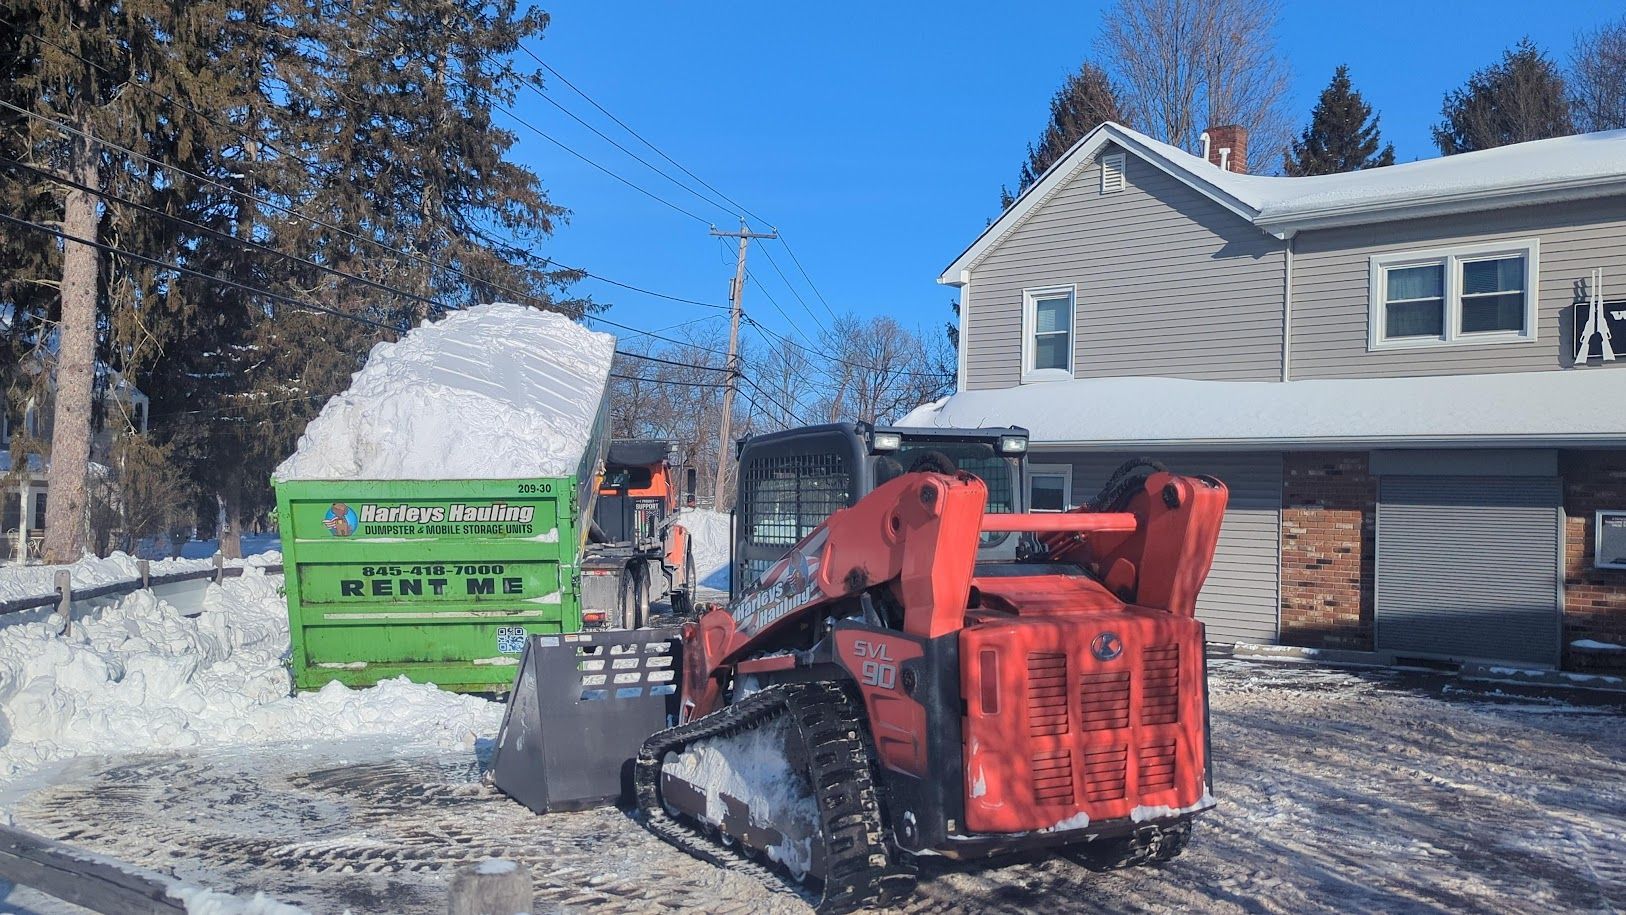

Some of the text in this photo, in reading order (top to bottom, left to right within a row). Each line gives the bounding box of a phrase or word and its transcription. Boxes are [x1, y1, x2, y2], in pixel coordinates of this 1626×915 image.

[518, 484, 552, 494] 209-30
[359, 503, 535, 524] Harleys Hauling
[365, 525, 415, 535] DUMPSTER
[426, 525, 461, 535] MOBILE
[463, 525, 503, 535] STORAGE
[505, 524, 533, 534] UNITS
[362, 565, 505, 576] 845-418-7000
[340, 577, 523, 597] RENT ME
[735, 582, 783, 622] Harleys
[759, 586, 811, 628] Hauling
[853, 639, 894, 662] SVL
[862, 660, 896, 690] 90
